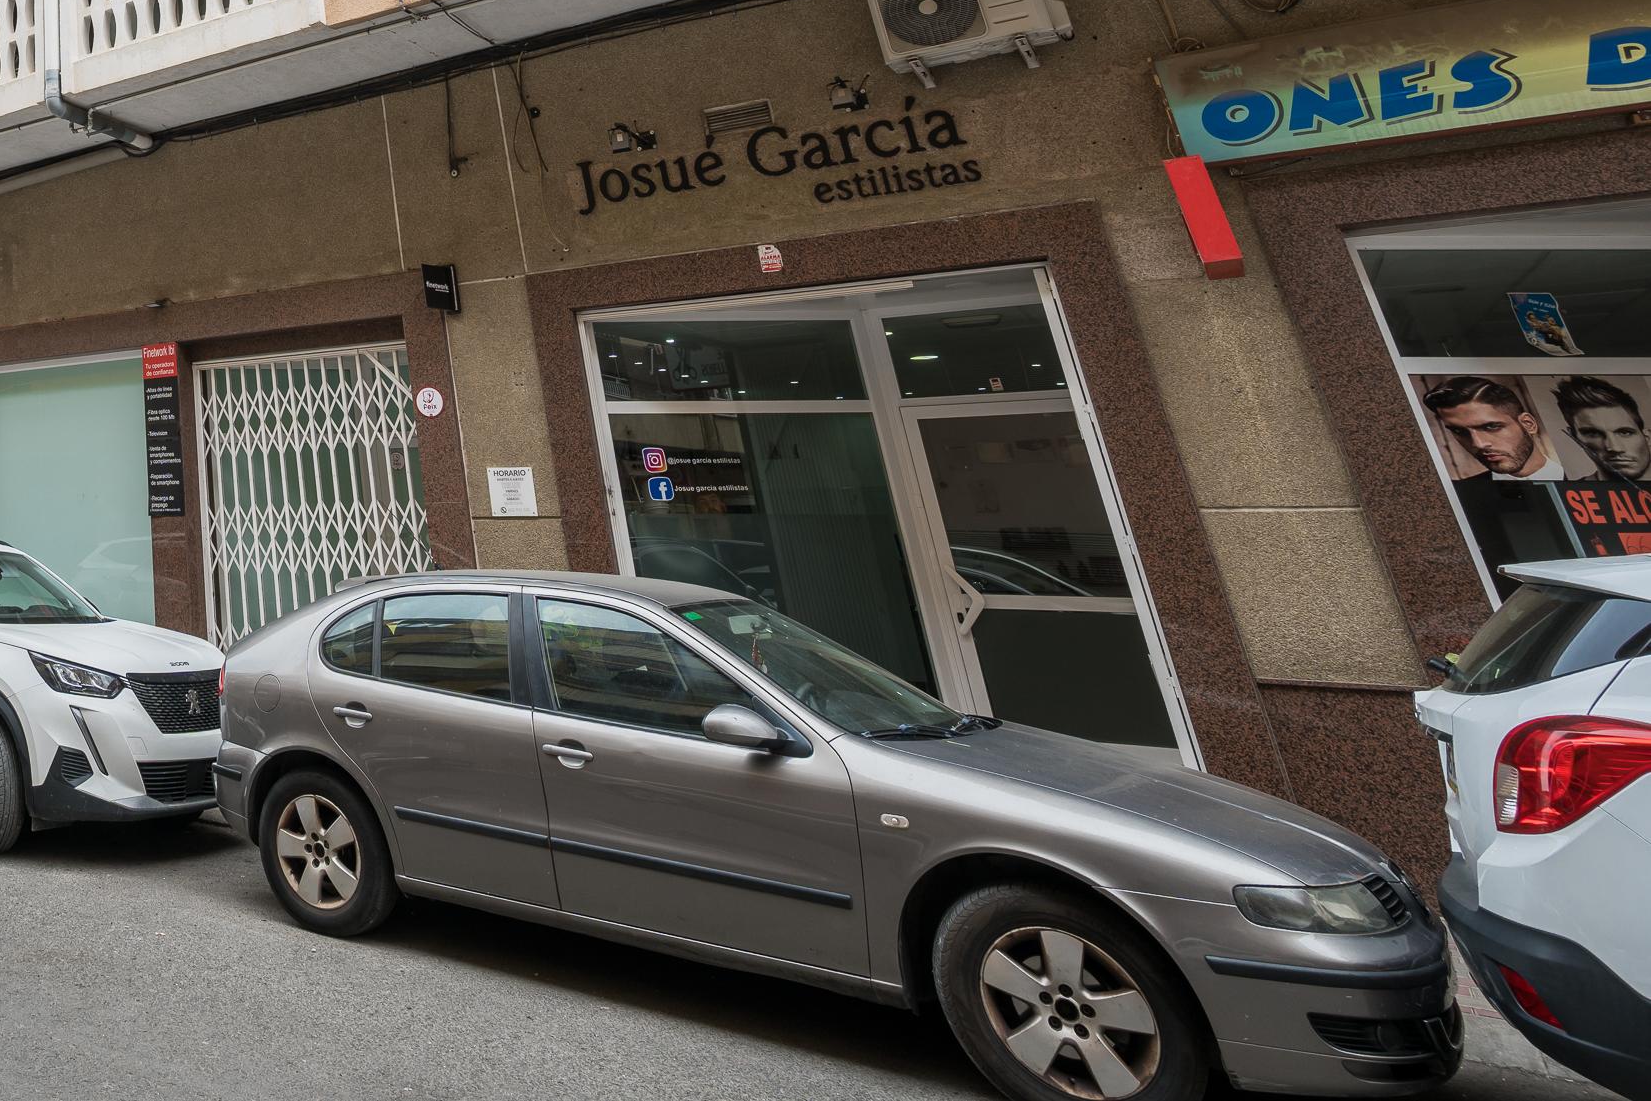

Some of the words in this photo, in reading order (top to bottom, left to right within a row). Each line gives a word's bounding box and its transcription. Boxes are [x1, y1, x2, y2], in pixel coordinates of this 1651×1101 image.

[1201, 48, 1522, 147] ONES
[576, 134, 727, 216] Josué
[747, 96, 968, 177] García
[813, 159, 982, 204] estilistas
[143, 346, 167, 359] Finetwork
[152, 361, 175, 370] operadora
[153, 368, 174, 377] confianza
[493, 469, 526, 477] HORARIO
[1565, 490, 1608, 525] SE
